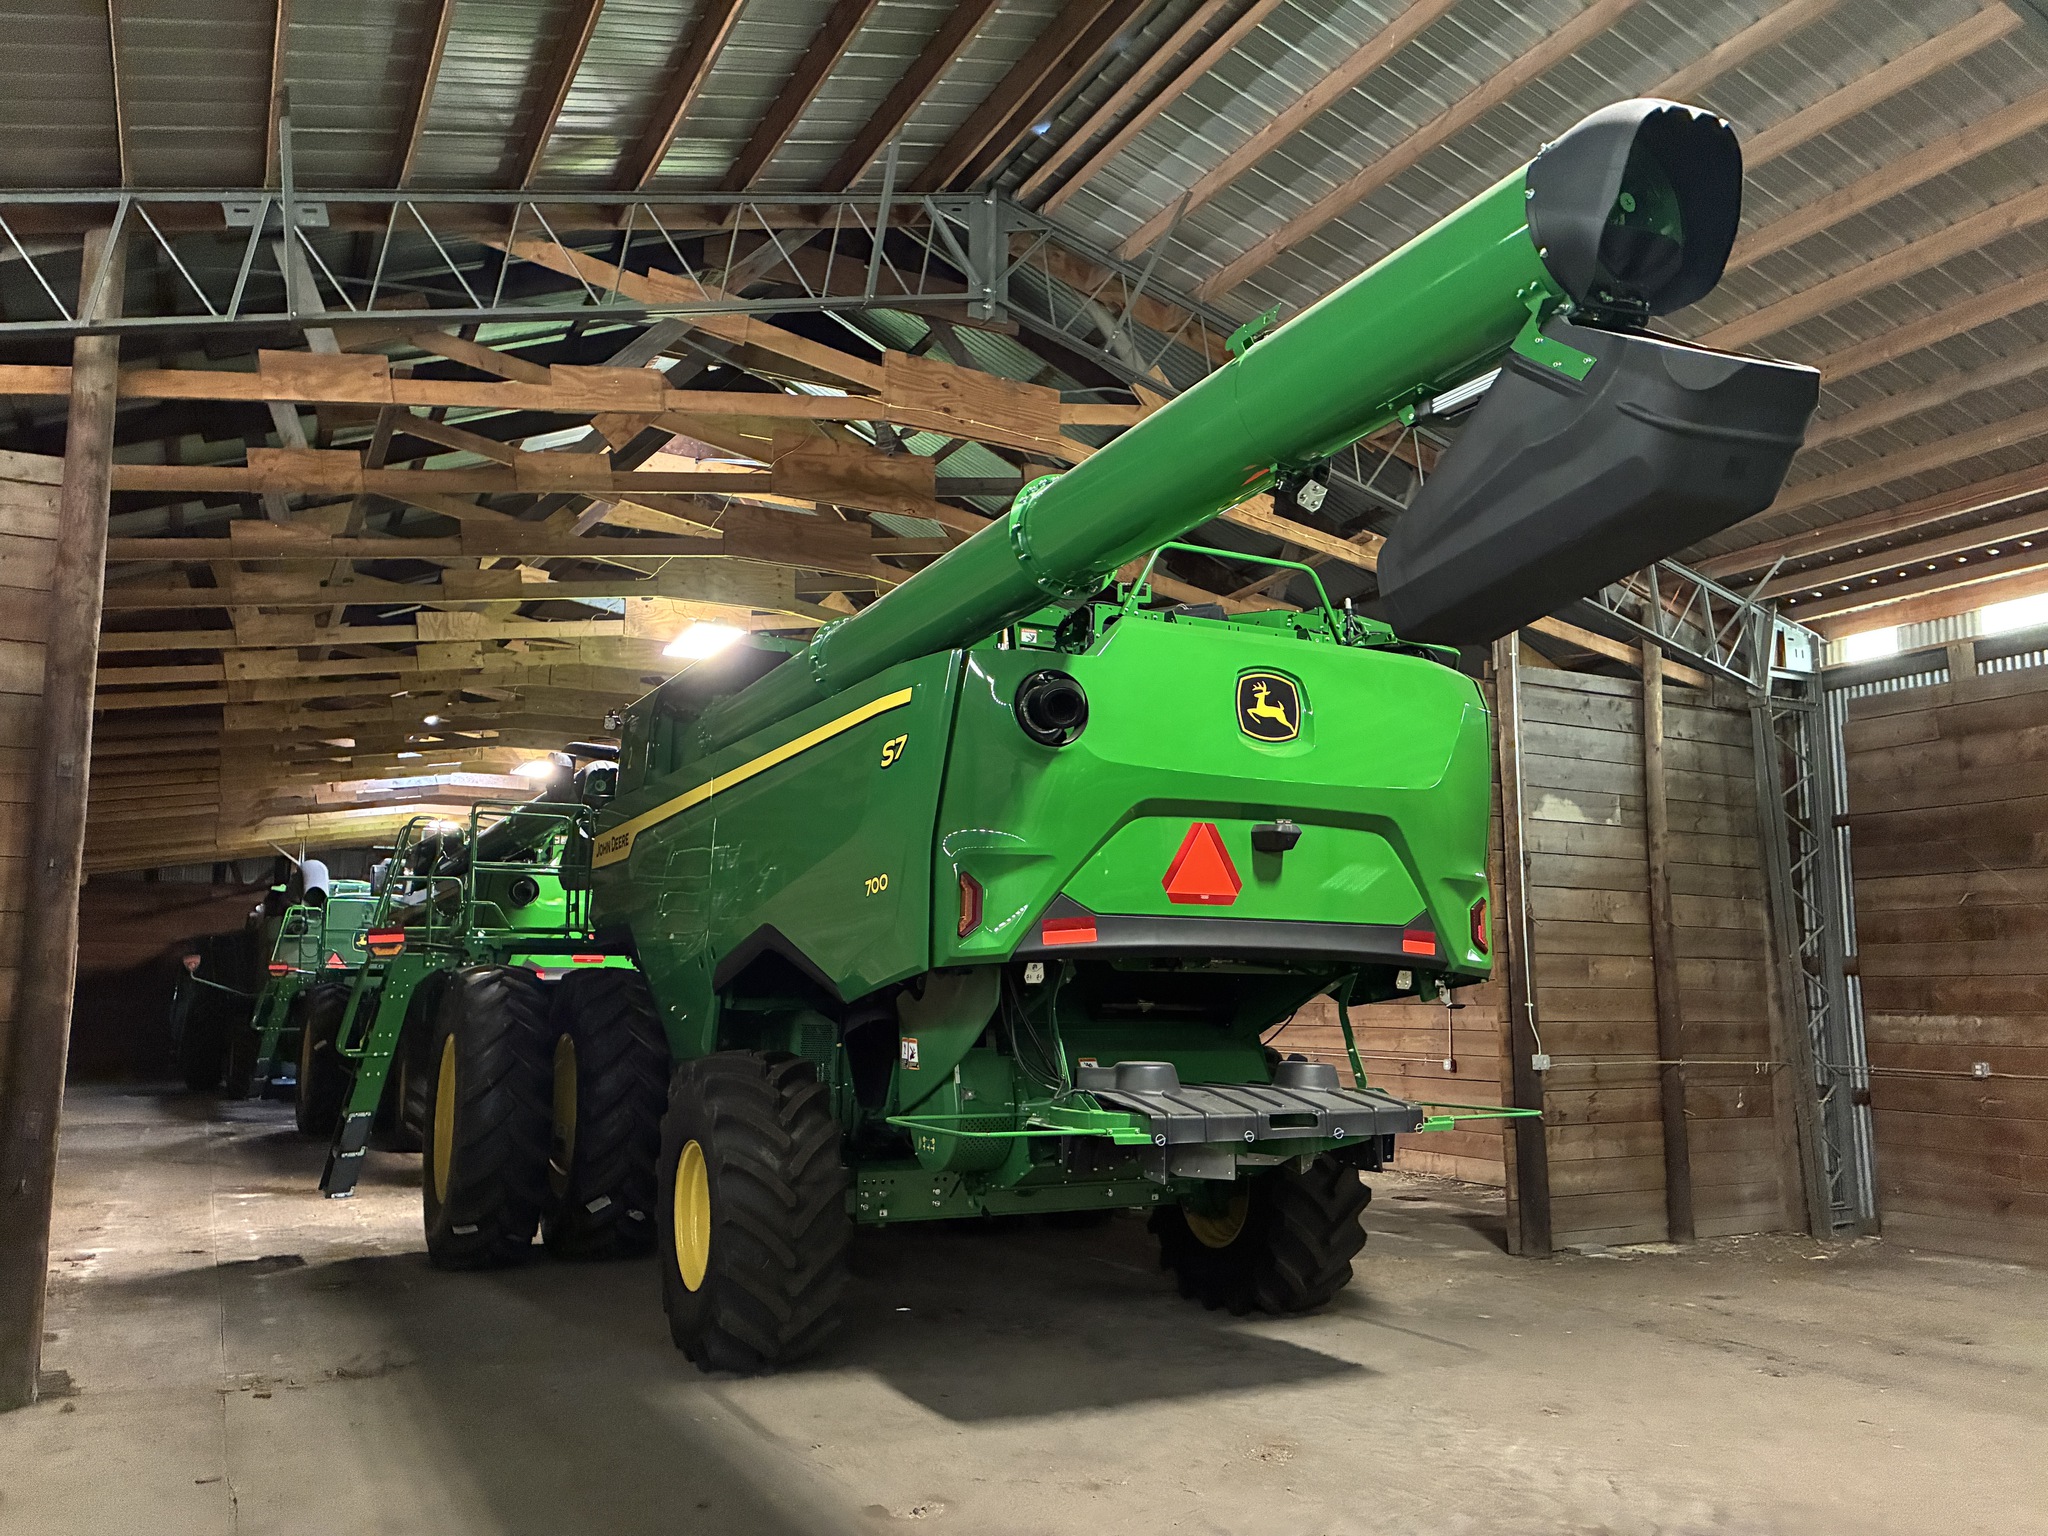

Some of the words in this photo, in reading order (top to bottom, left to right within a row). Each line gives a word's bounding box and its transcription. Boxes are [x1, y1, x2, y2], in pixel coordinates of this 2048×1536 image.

[880, 733, 909, 768] S7
[596, 840, 611, 857] JOHN
[611, 832, 629, 852] DEERE
[864, 873, 889, 897] 700
